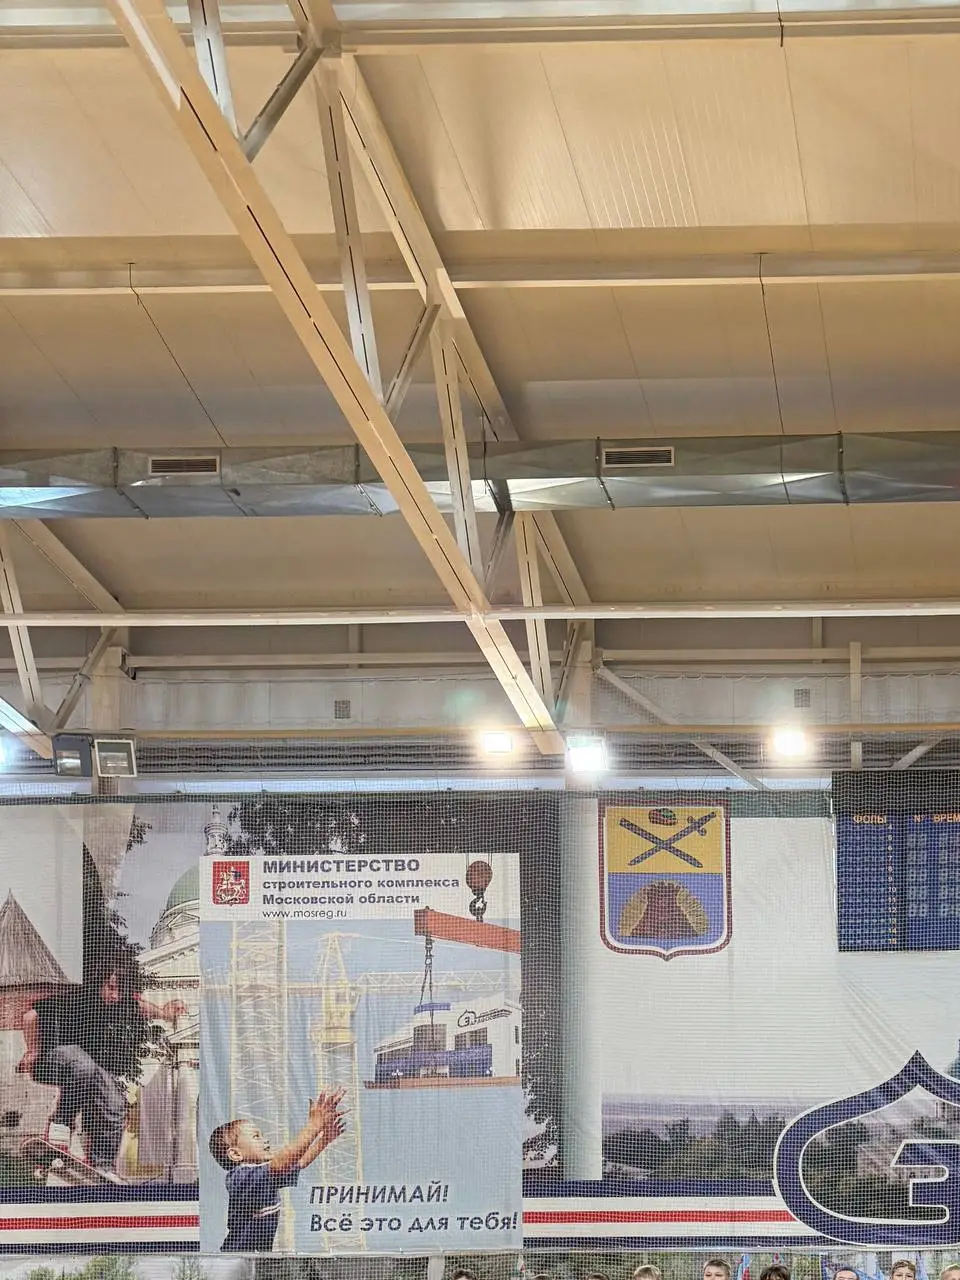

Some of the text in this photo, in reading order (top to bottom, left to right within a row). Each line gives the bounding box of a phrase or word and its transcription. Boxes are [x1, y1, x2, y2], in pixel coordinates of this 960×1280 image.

[853, 813, 887, 824] ФОЛЫ
[262, 858, 420, 873] МИНИСТЕРСТВО
[262, 878, 460, 891] строительного комплекса
[262, 892, 420, 905] Московской области
[262, 909, 347, 920] www.mosreg.ru
[309, 1180, 449, 1204] ПРИНИМАЙ!
[310, 1211, 518, 1233] Всё это для тебя!
